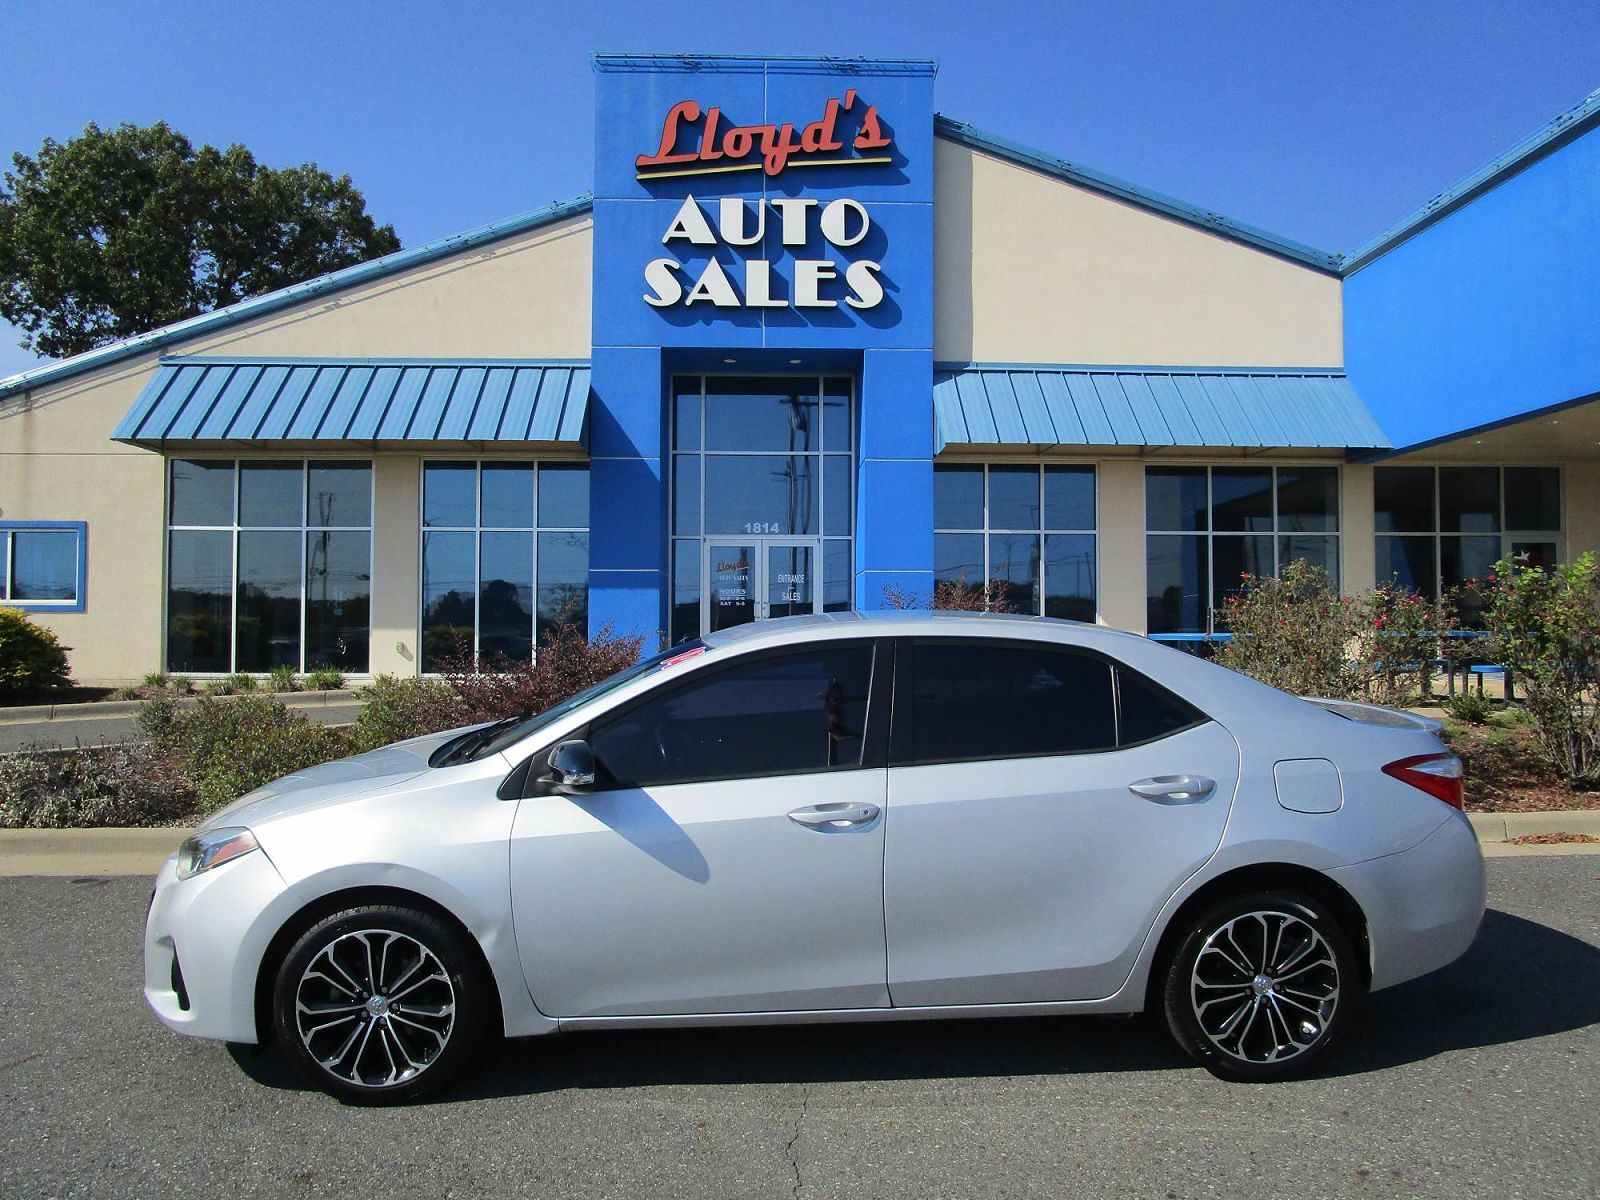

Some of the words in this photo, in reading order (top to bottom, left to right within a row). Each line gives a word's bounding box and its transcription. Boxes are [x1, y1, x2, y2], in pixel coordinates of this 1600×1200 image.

[635, 89, 892, 176] Lloyd's
[661, 194, 870, 246] AUTO
[643, 256, 884, 308] SALES
[744, 522, 780, 533] 1814
[716, 559, 749, 573] Lloyd
[777, 574, 805, 583] ENTRANCE
[781, 592, 801, 601] SALES
